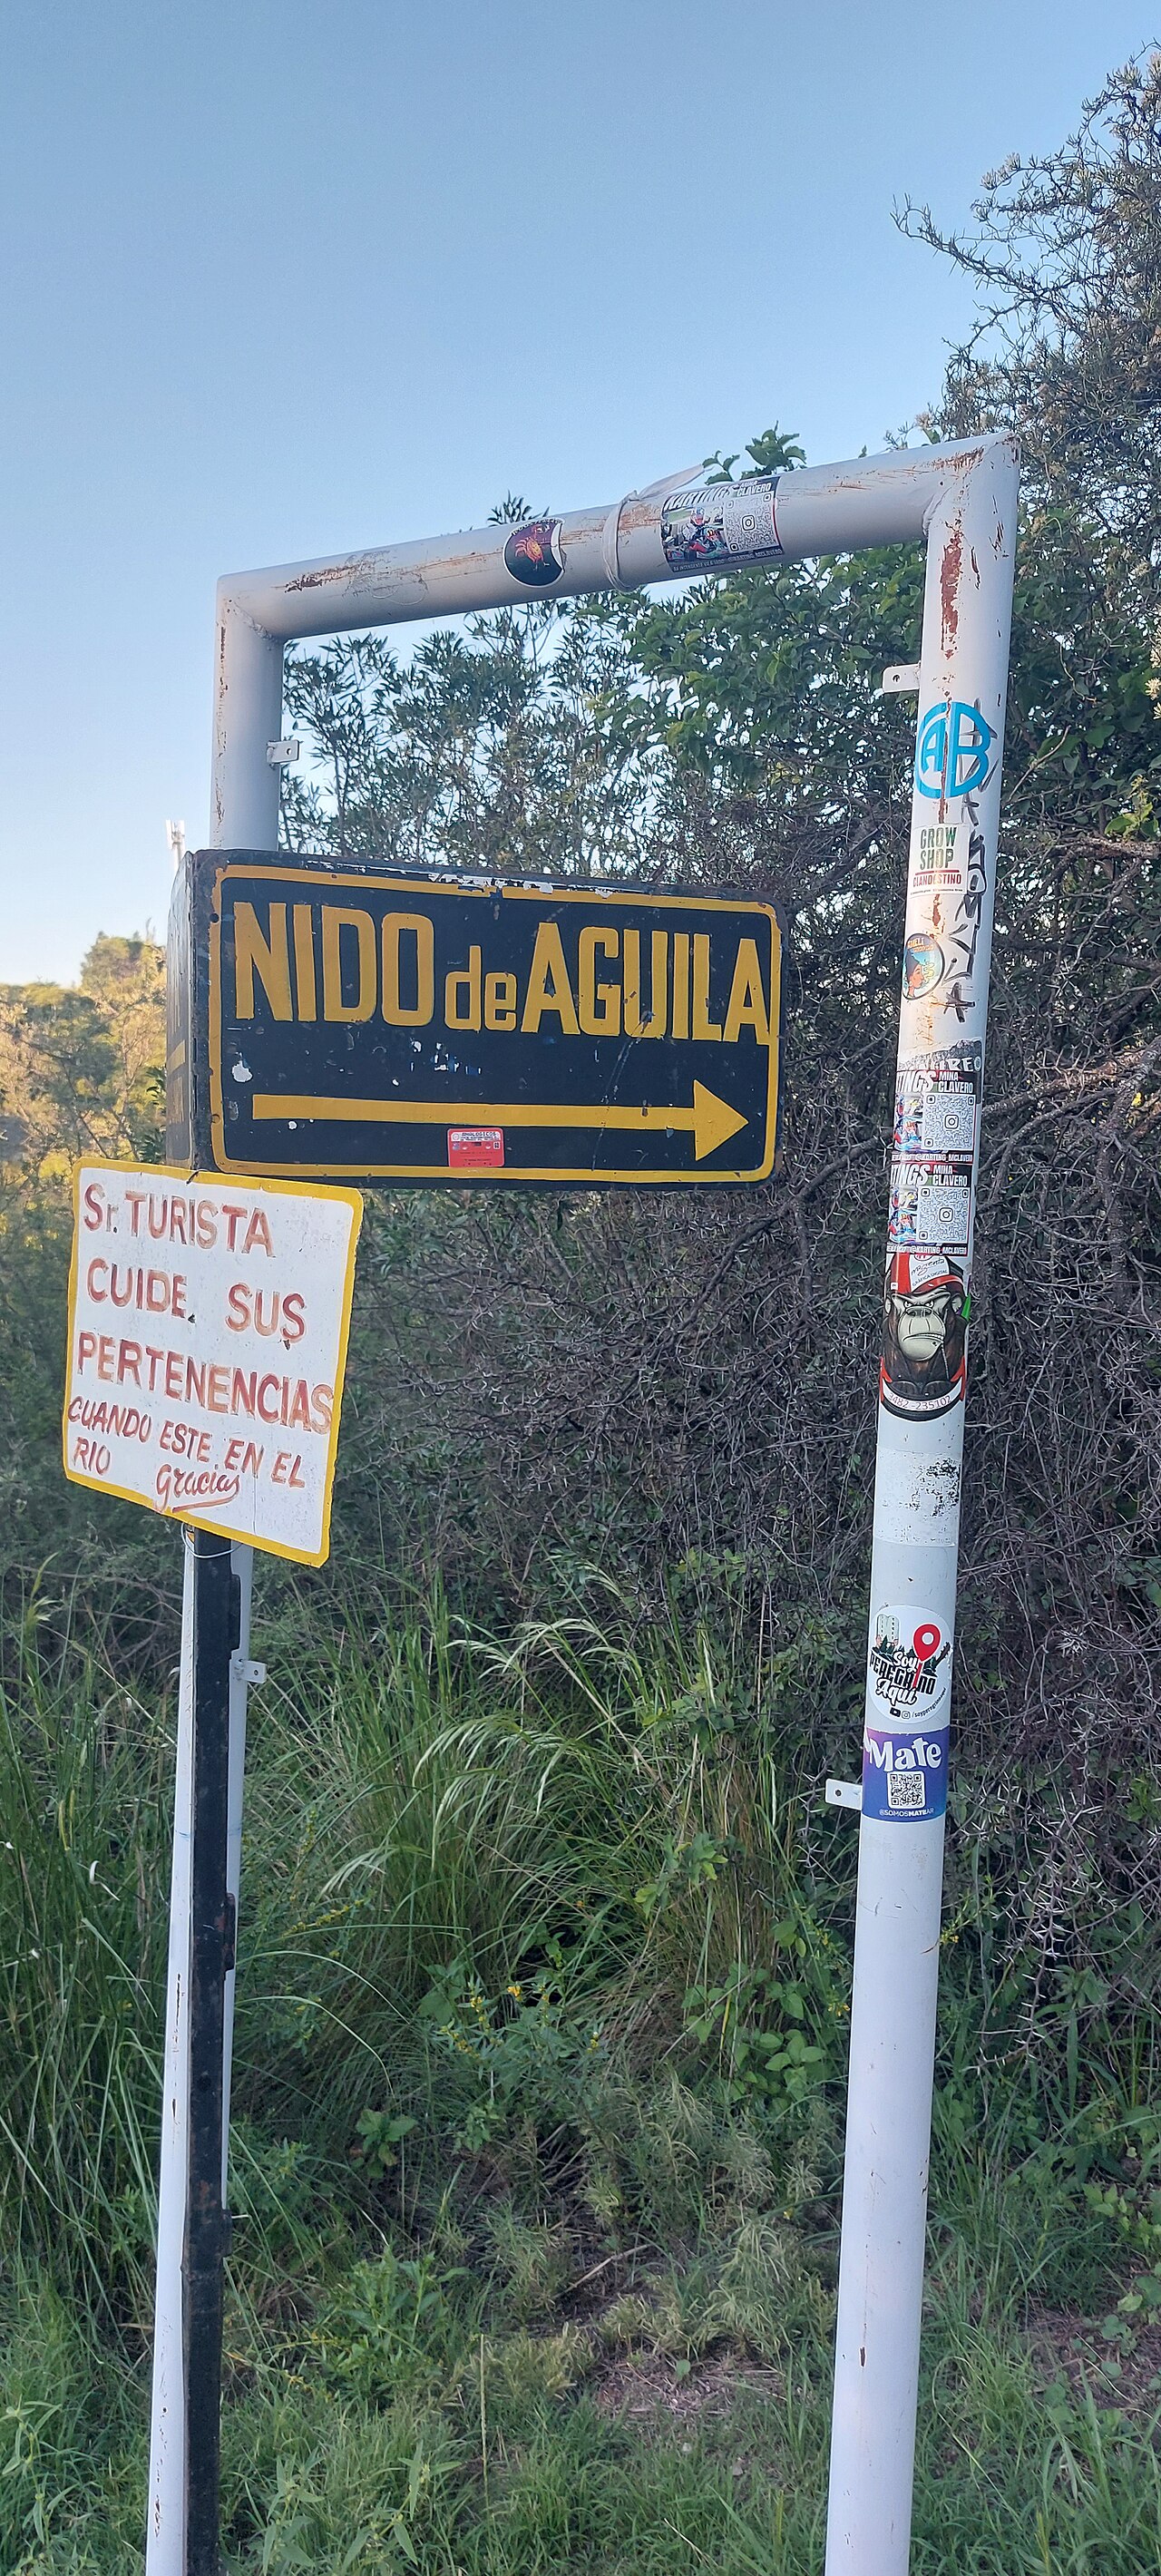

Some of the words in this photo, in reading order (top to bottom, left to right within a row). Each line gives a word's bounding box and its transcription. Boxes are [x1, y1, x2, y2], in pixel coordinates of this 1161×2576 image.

[737, 483, 771, 496] CLAVERO
[920, 827, 957, 849] GROW
[920, 848, 953, 870] SHOP
[912, 873, 961, 887] CLANDESTINO
[234, 902, 434, 1027] NIDO
[445, 944, 517, 1032] de
[521, 922, 770, 1045] AGUILA
[938, 1071, 959, 1081] MINA
[938, 1081, 973, 1094] CLAVERO
[932, 1175, 968, 1186] CLAVERO
[83, 1183, 119, 1234] Sr.
[124, 1190, 277, 1258] TURISTA
[87, 1257, 189, 1318] CUIDE
[226, 1283, 307, 1343] SUS
[78, 1332, 335, 1434] PERTENENCIAS
[67, 1396, 152, 1443] CUANDO
[160, 1420, 210, 1463] ESTE
[224, 1439, 264, 1478] EN
[271, 1452, 306, 1488] EL
[73, 1436, 112, 1476] RIO
[870, 1651, 937, 1695] PEREGRINO
[893, 1651, 918, 1673] Soy
[864, 1729, 941, 1771] Mate
